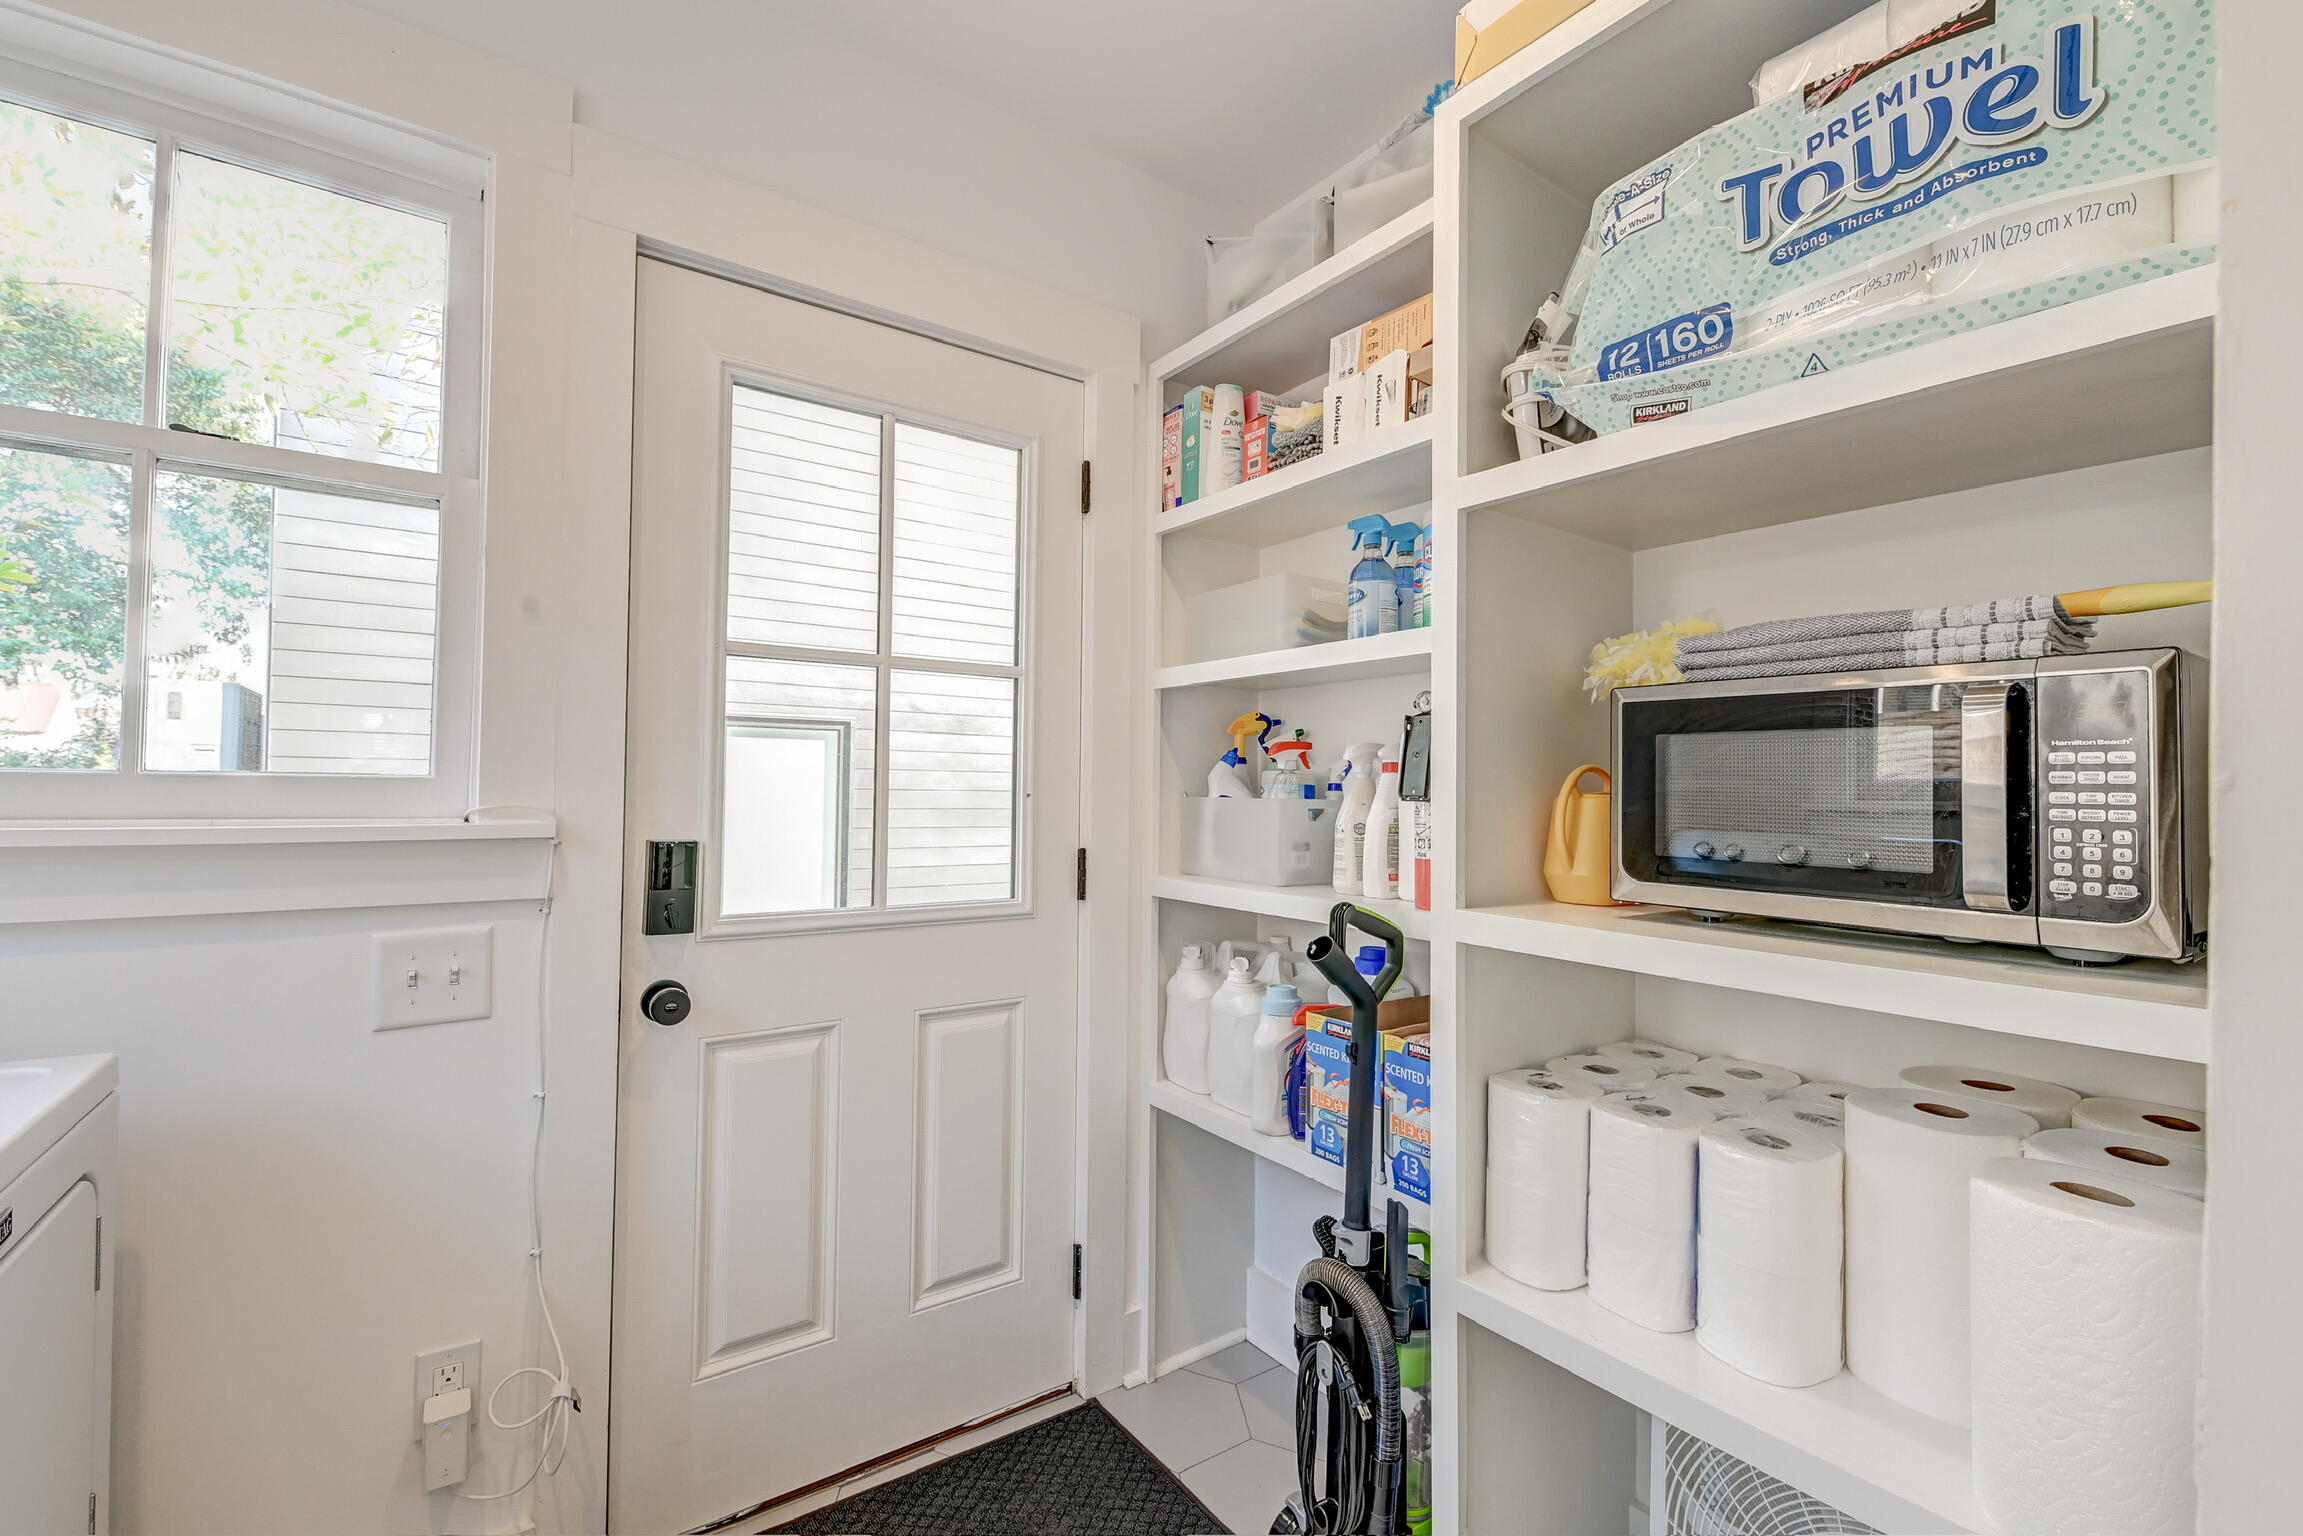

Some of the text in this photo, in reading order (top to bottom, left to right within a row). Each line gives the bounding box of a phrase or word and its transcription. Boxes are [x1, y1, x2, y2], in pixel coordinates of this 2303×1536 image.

[1806, 47, 1993, 160] PREMIUM
[1722, 23, 2092, 244] Towel
[1776, 150, 2038, 260] Strong, Thick and Absorbent
[1619, 213, 1655, 236] or Whole
[1863, 272, 1891, 297] (95.3
[1945, 246, 1959, 266] IN
[1962, 247, 1970, 262] x
[1972, 237, 1979, 257] 7
[1981, 231, 1996, 253] IN
[2000, 221, 2032, 250] (27.9
[2036, 215, 2059, 237] cm
[2063, 212, 2073, 230] x
[2077, 202, 2102, 225] 17.7
[2106, 192, 2137, 217] cm)
[1655, 314, 1725, 358] 160
[1608, 341, 1640, 371] 12
[1657, 342, 1725, 368] SHEETS PER ROLL
[1607, 365, 1642, 381] ROLLS
[1810, 362, 1818, 372] 4
[1375, 374, 1383, 427] Kwikset
[1610, 379, 1711, 402] Shop www.costco.com
[1333, 395, 1342, 446] Kwikset
[1635, 401, 1686, 417] KIRKLAND
[1223, 416, 1243, 427] Dove
[1306, 1040, 1340, 1060] SCENTED
[1409, 1043, 1430, 1057] KIRKL
[1385, 1062, 1424, 1085] SCENTED
[1310, 1086, 1349, 1117] FLEX-T
[1337, 1116, 1348, 1127] SCEN
[1390, 1111, 1431, 1145] FLEX-T
[1319, 1124, 1335, 1144] 13
[1320, 1138, 1334, 1149] GALLON
[1315, 1146, 1340, 1164] 200 BAGS
[1401, 1154, 1419, 1176] 13
[1402, 1170, 1419, 1182] GALLON
[1398, 1178, 1427, 1198] 200 BAGS
